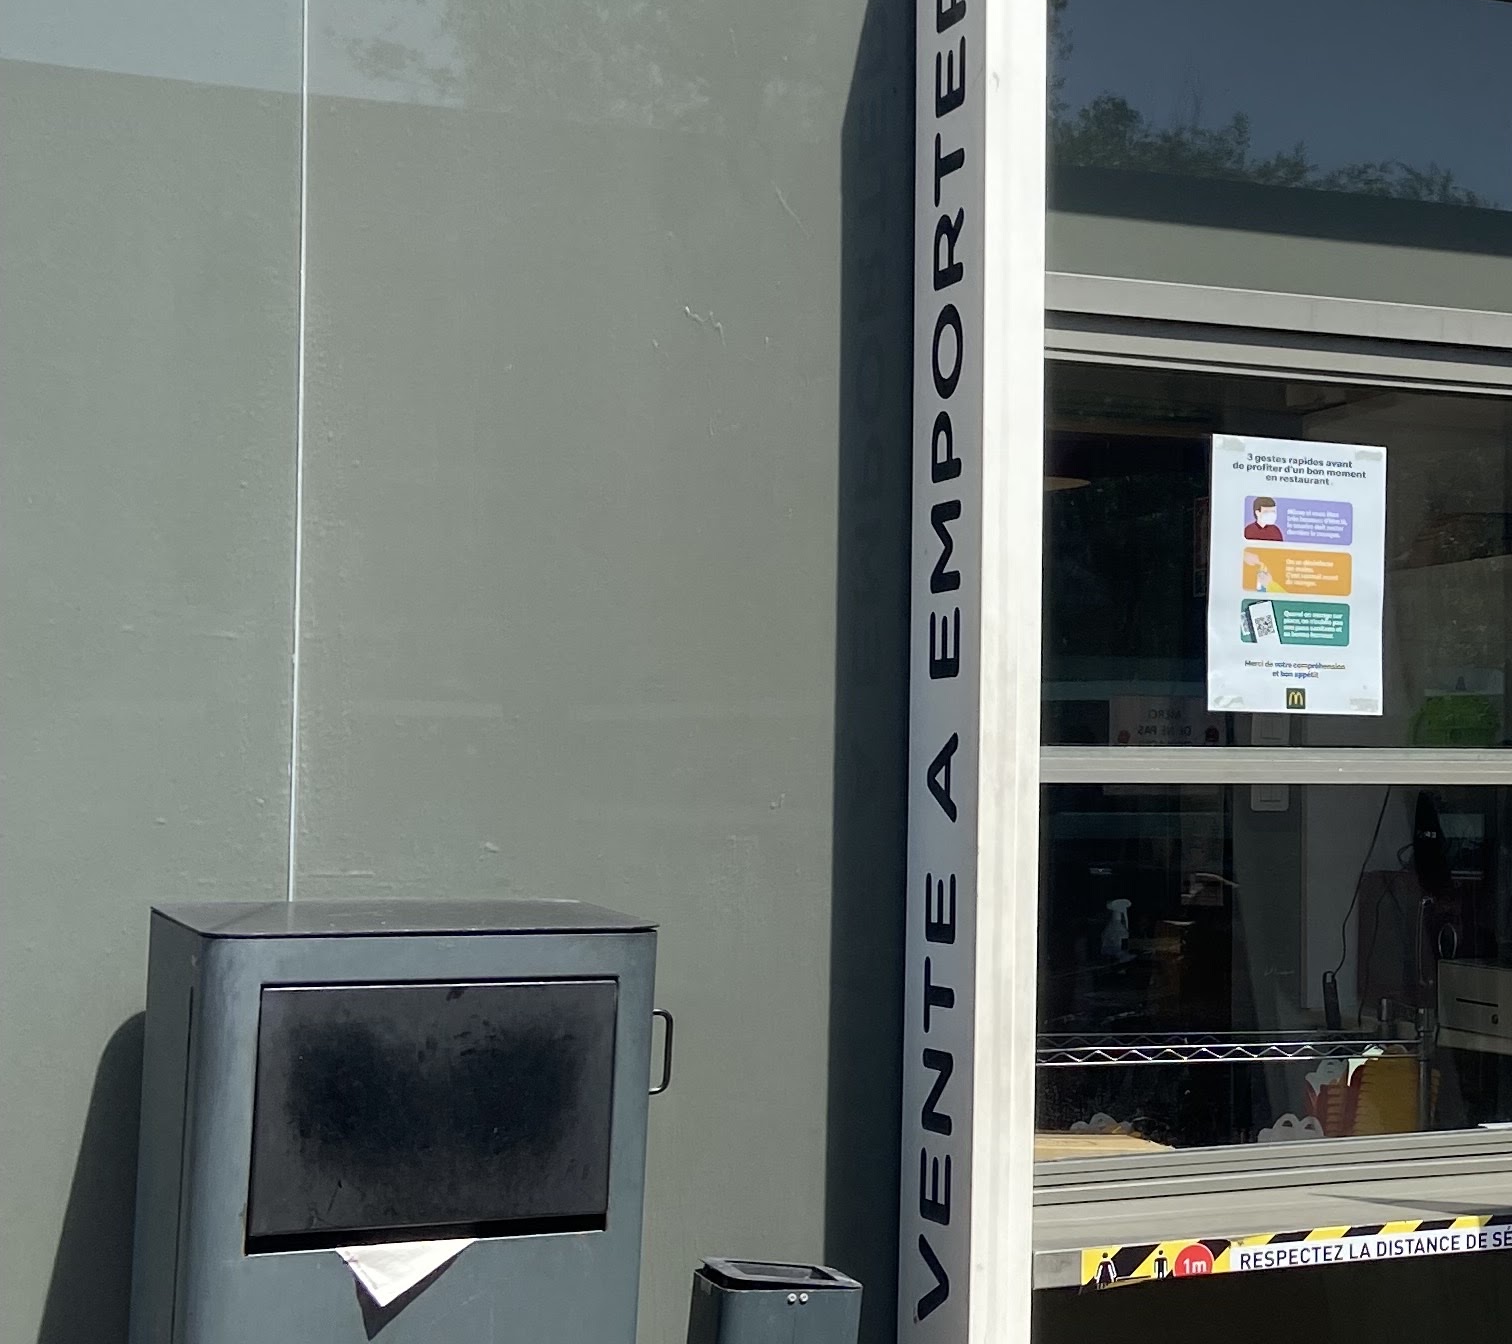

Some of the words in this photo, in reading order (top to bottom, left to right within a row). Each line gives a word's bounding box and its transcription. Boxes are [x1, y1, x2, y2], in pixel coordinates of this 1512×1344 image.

[1247, 453, 1253, 461] 3
[1326, 460, 1353, 469] avant
[1306, 467, 1325, 476] bon
[927, 732, 959, 823] A
[914, 872, 956, 1322] VENTE
[1240, 1244, 1344, 1270] RESPECTEZ
[1349, 1245, 1369, 1260] LA
[1376, 1233, 1461, 1258] DISTANCE
[1466, 1232, 1487, 1250] DE
